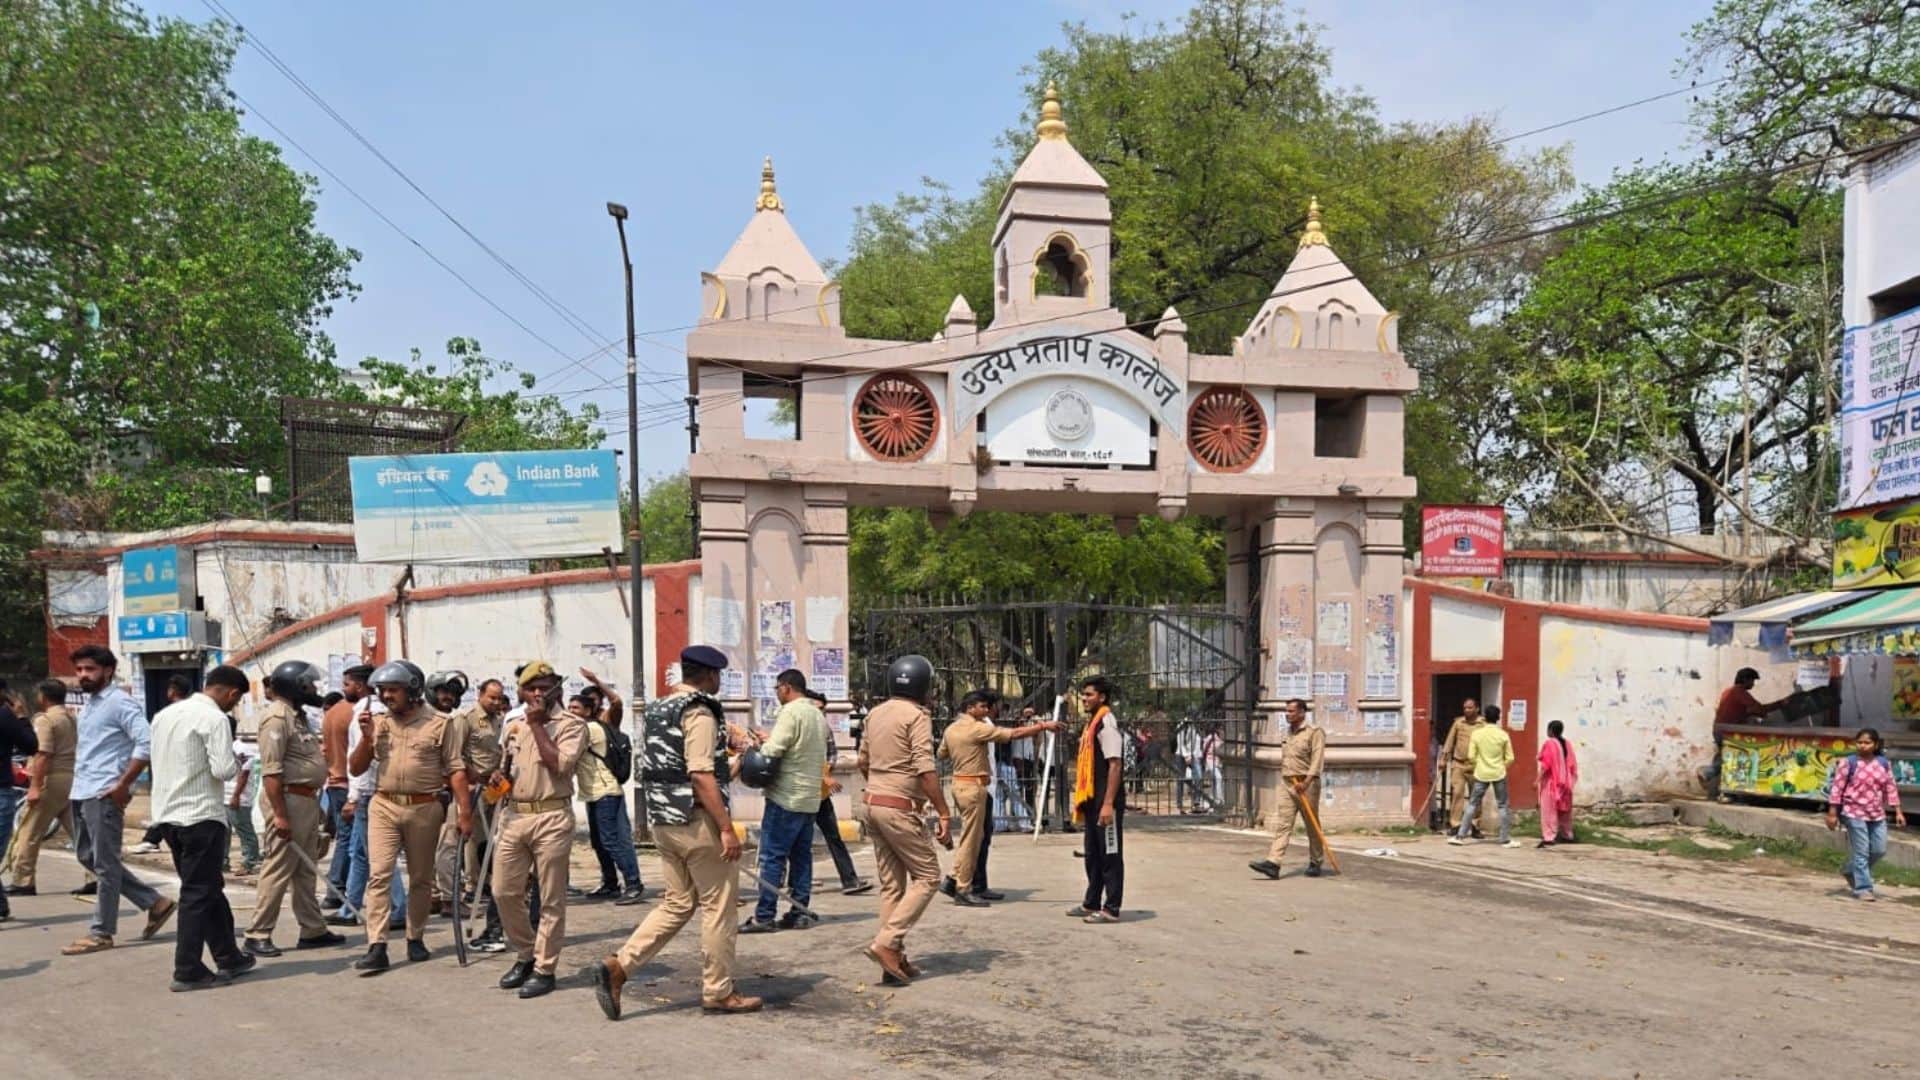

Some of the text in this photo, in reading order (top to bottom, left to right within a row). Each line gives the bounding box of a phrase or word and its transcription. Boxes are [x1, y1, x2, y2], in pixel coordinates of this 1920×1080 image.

[962, 350, 1016, 395] उदय
[1017, 337, 1093, 365] प्रताप
[1098, 341, 1181, 407] कालेज
[376, 465, 451, 487] इंडियन बैंक
[517, 463, 599, 481] Indian Bank
